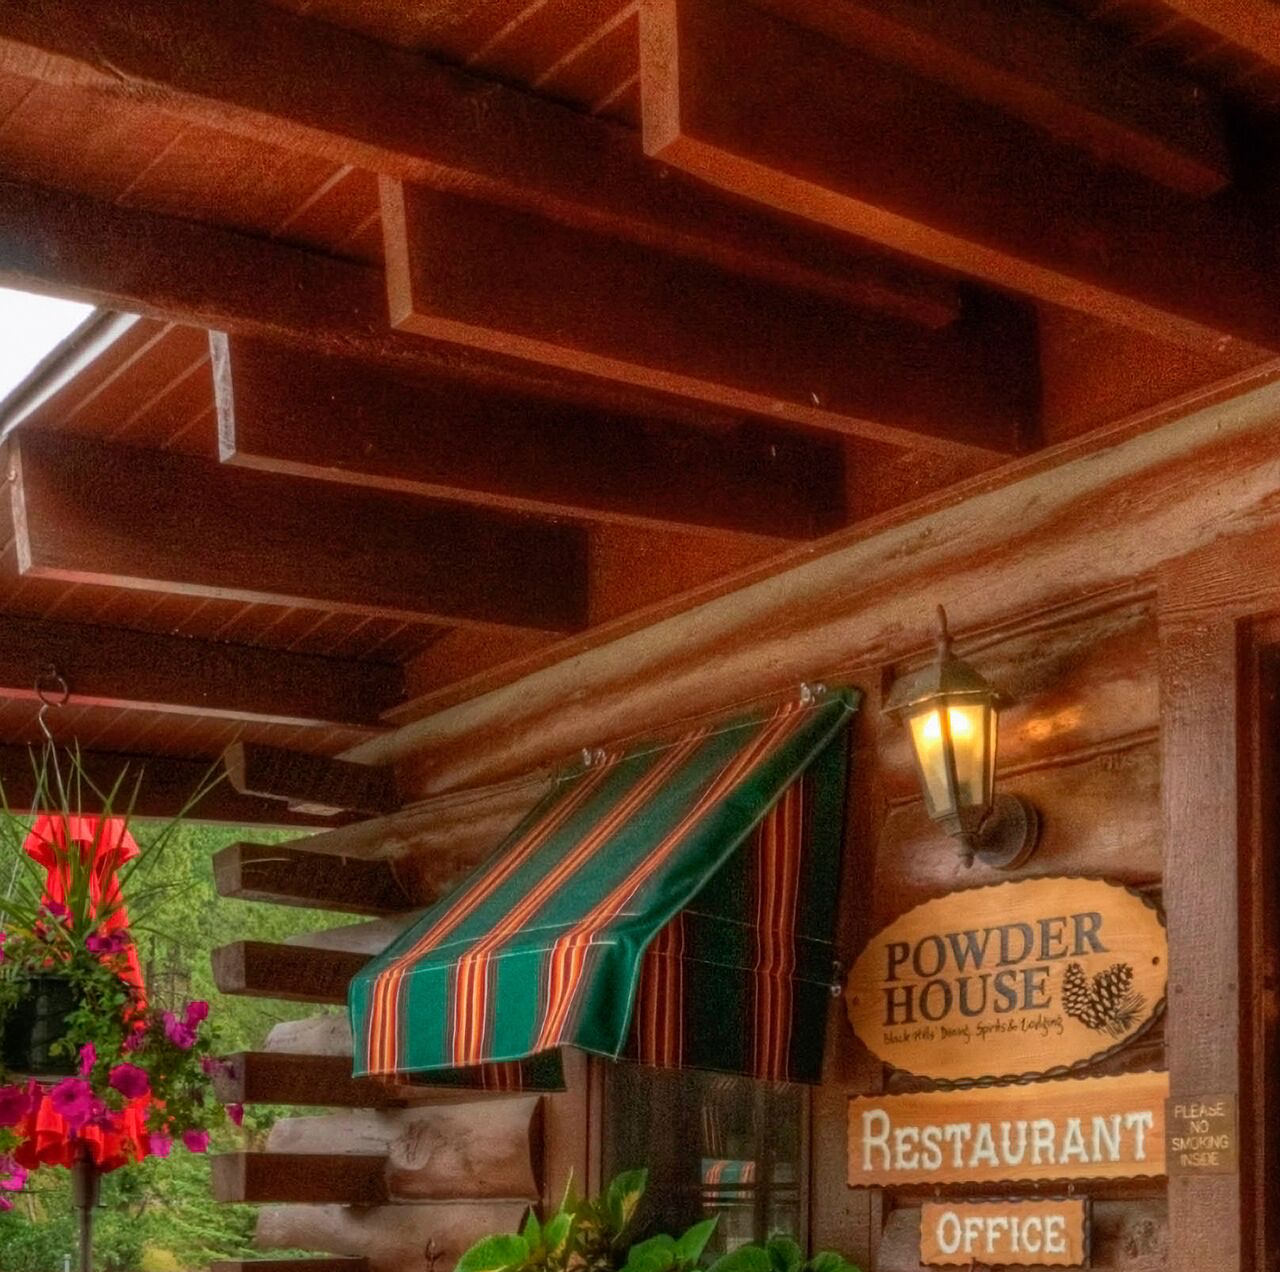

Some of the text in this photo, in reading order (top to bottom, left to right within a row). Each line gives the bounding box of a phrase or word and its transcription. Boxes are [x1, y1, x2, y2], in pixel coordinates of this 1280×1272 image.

[884, 911, 1111, 982] POWDER
[881, 965, 1052, 1027] HOUSE
[1174, 1102, 1225, 1118] PLEASE
[861, 1108, 1154, 1171] RESTAURANT
[1190, 1119, 1209, 1133] NO
[1172, 1134, 1229, 1151] SMOKING
[1180, 1151, 1220, 1167] INSIDE
[936, 1211, 1067, 1254] OFFICE
